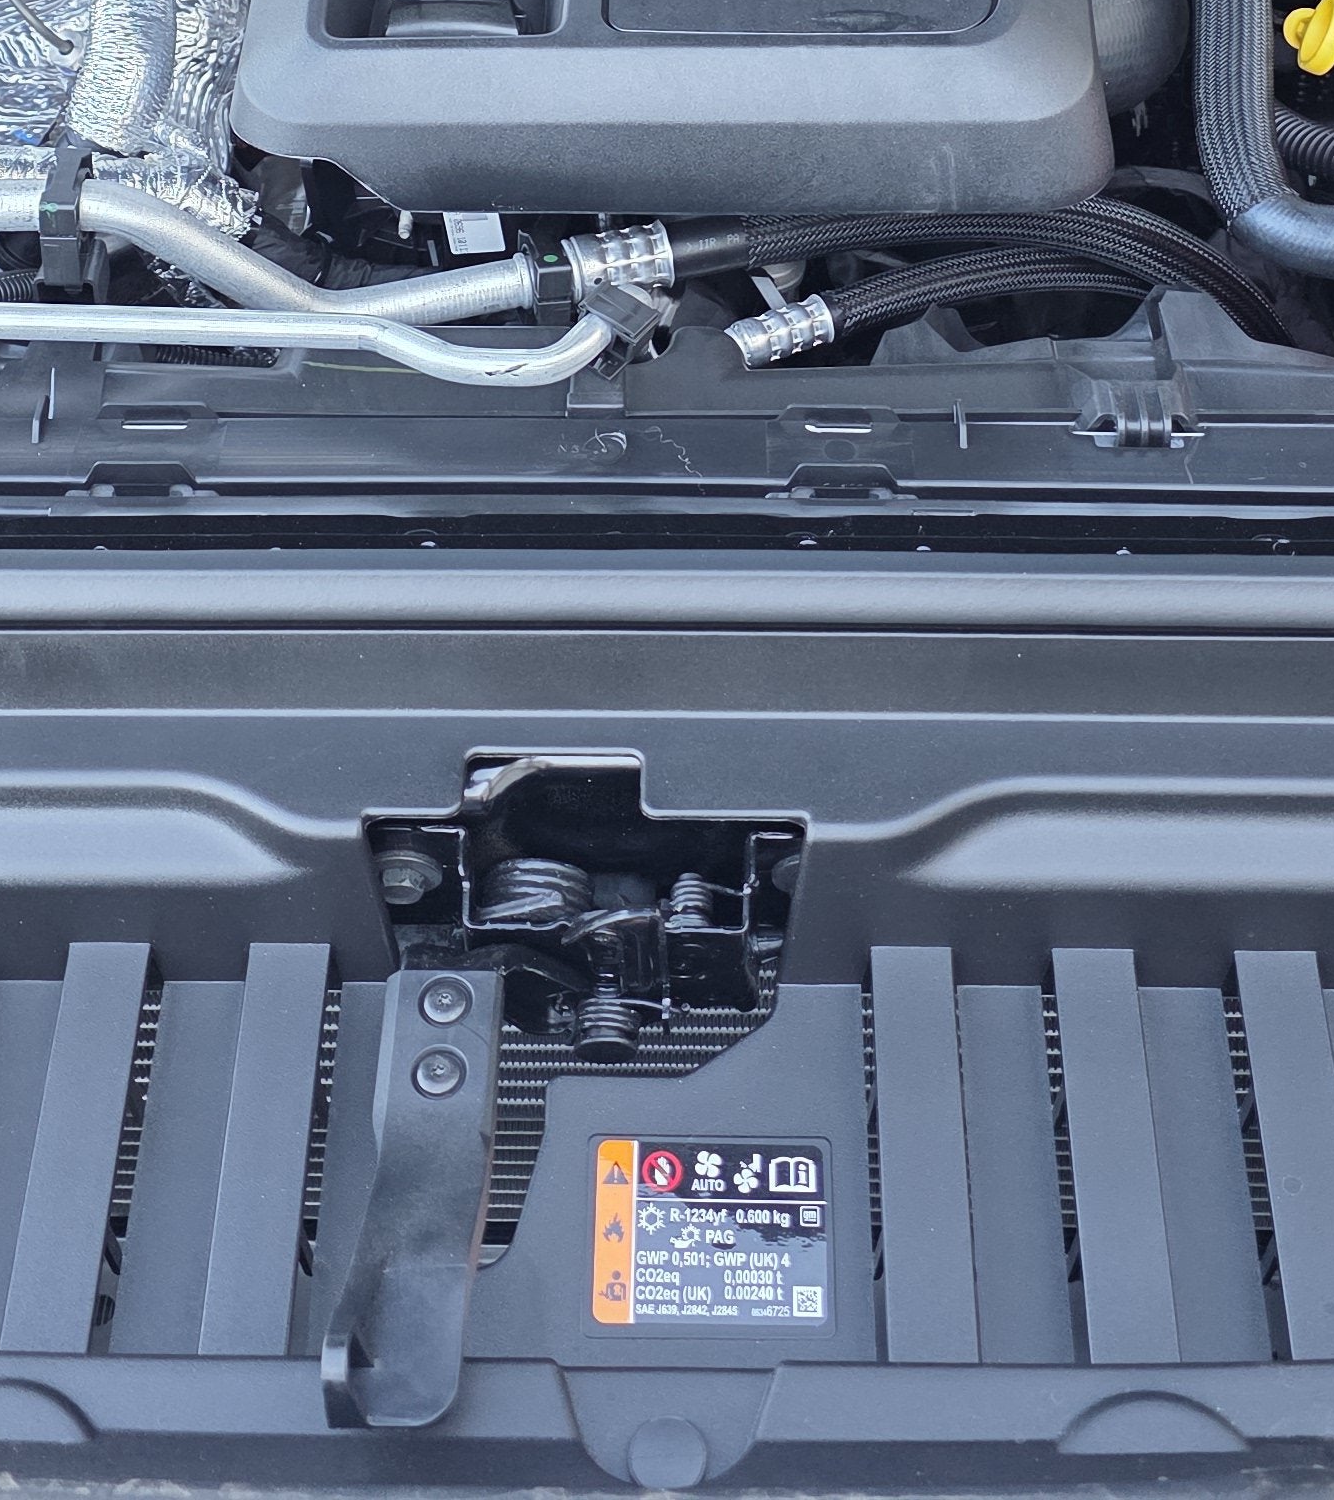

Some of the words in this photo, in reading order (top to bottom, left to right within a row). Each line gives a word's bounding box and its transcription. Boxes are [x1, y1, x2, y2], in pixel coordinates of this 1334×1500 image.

[691, 1179, 724, 1191] AUTO
[670, 1208, 727, 1224] R-1234yf
[735, 1209, 769, 1224] 0.600
[773, 1209, 790, 1228] kg
[705, 1230, 735, 1244] PAG
[636, 1252, 668, 1265] GWP
[713, 1253, 746, 1267] GWP
[749, 1252, 778, 1269] (UK)
[780, 1253, 791, 1267] 4
[635, 1268, 680, 1285] CO2eq
[775, 1271, 784, 1285] t
[635, 1285, 680, 1302] CO2eq
[682, 1286, 712, 1303] (UK)
[776, 1287, 784, 1300] t
[635, 1304, 655, 1314] SAE
